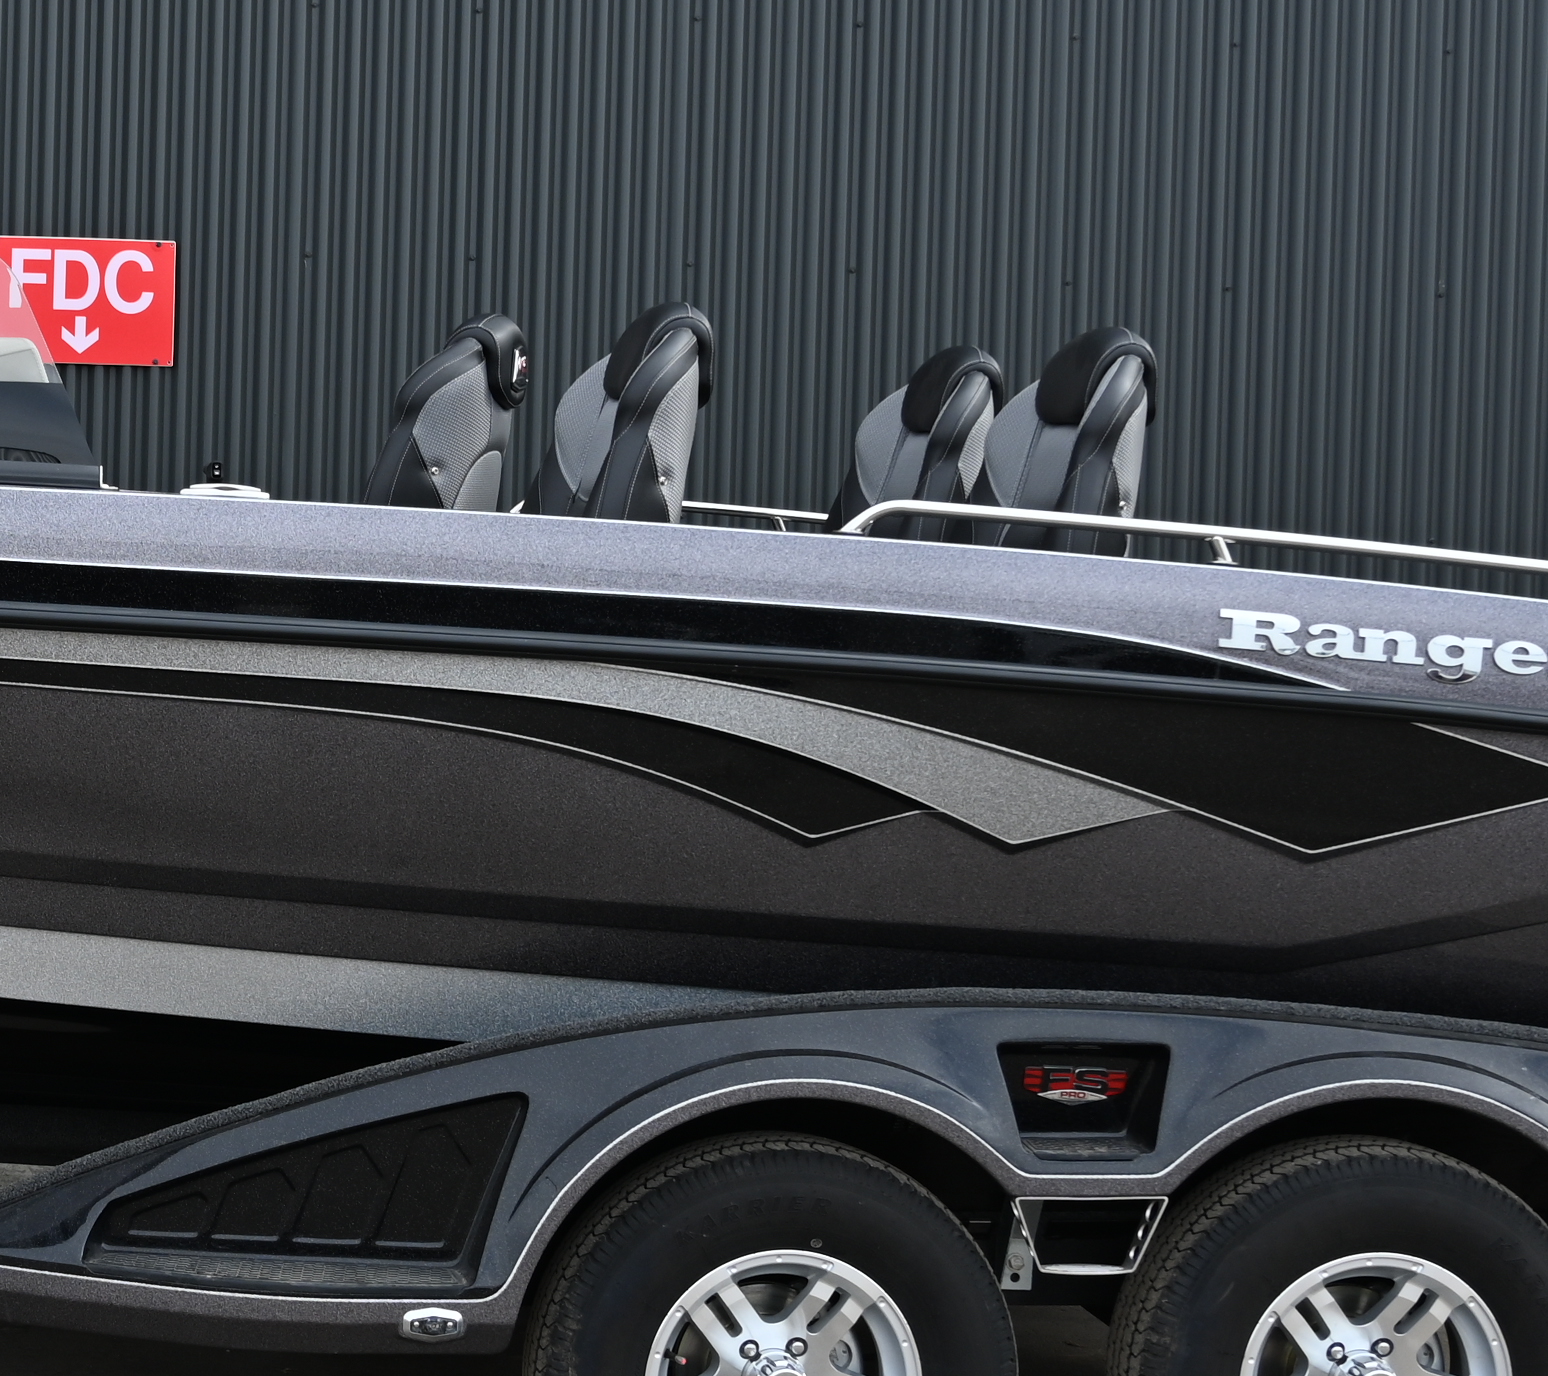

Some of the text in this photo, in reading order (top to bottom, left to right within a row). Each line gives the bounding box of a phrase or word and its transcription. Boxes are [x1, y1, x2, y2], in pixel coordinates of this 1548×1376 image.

[8, 248, 154, 315] FDC
[1040, 1064, 1110, 1091] FS
[1060, 1090, 1087, 1099] PRO
